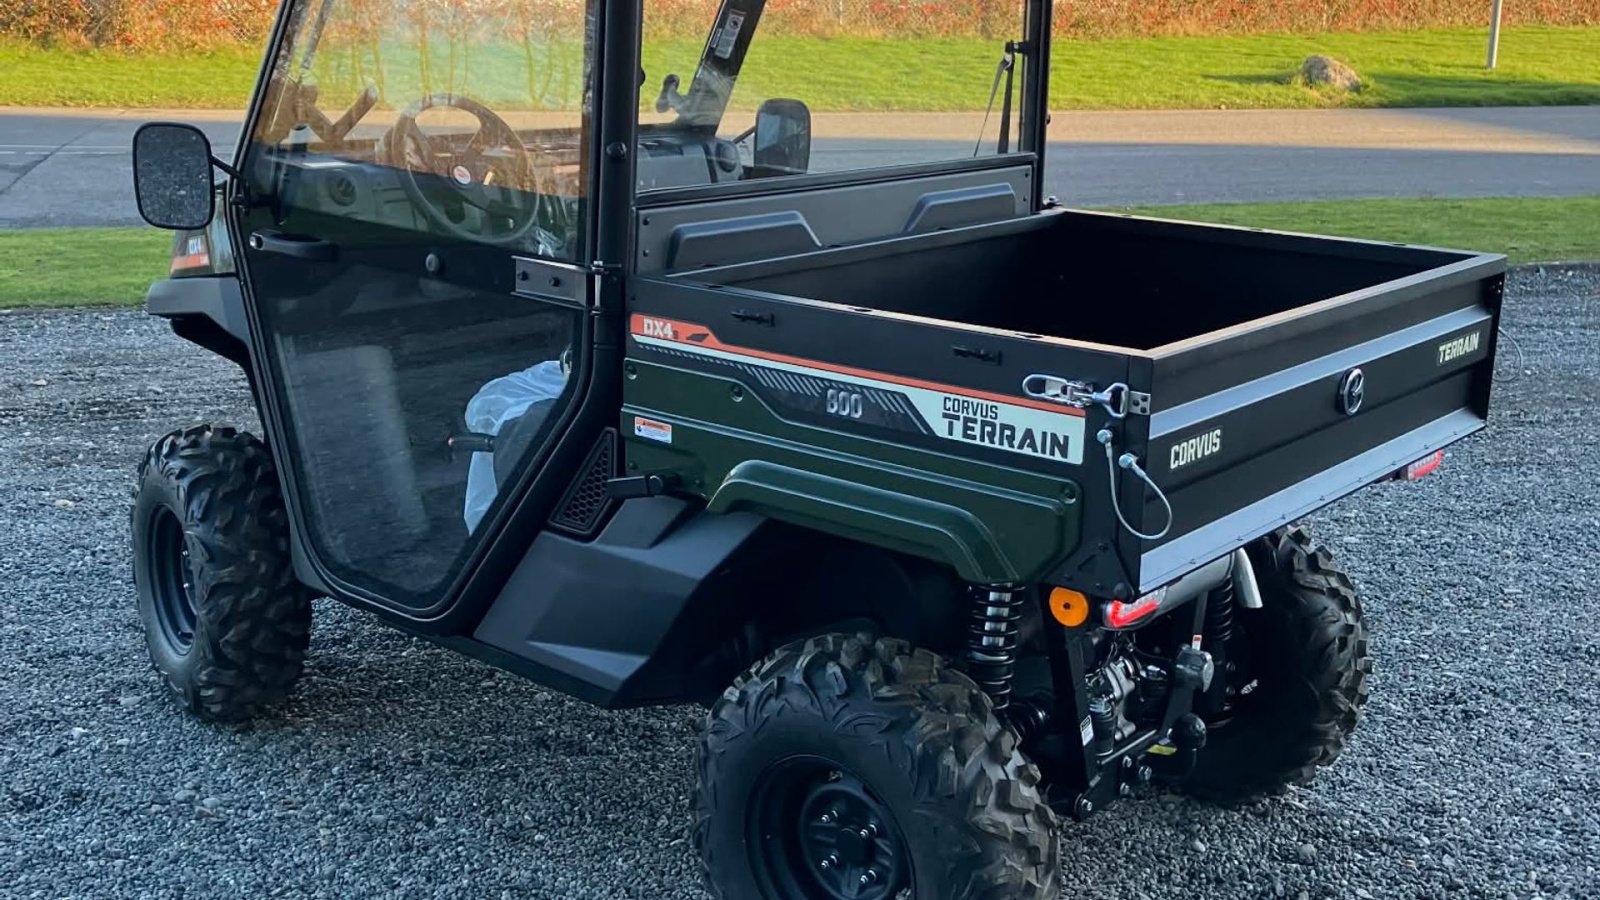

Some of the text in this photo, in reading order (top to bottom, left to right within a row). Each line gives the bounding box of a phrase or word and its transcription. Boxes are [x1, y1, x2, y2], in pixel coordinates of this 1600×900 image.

[1439, 332, 1479, 363] TERRAIN
[943, 397, 998, 419] CORVUS
[943, 412, 1069, 459] TERRAIN
[1170, 429, 1221, 469] CORVUS
